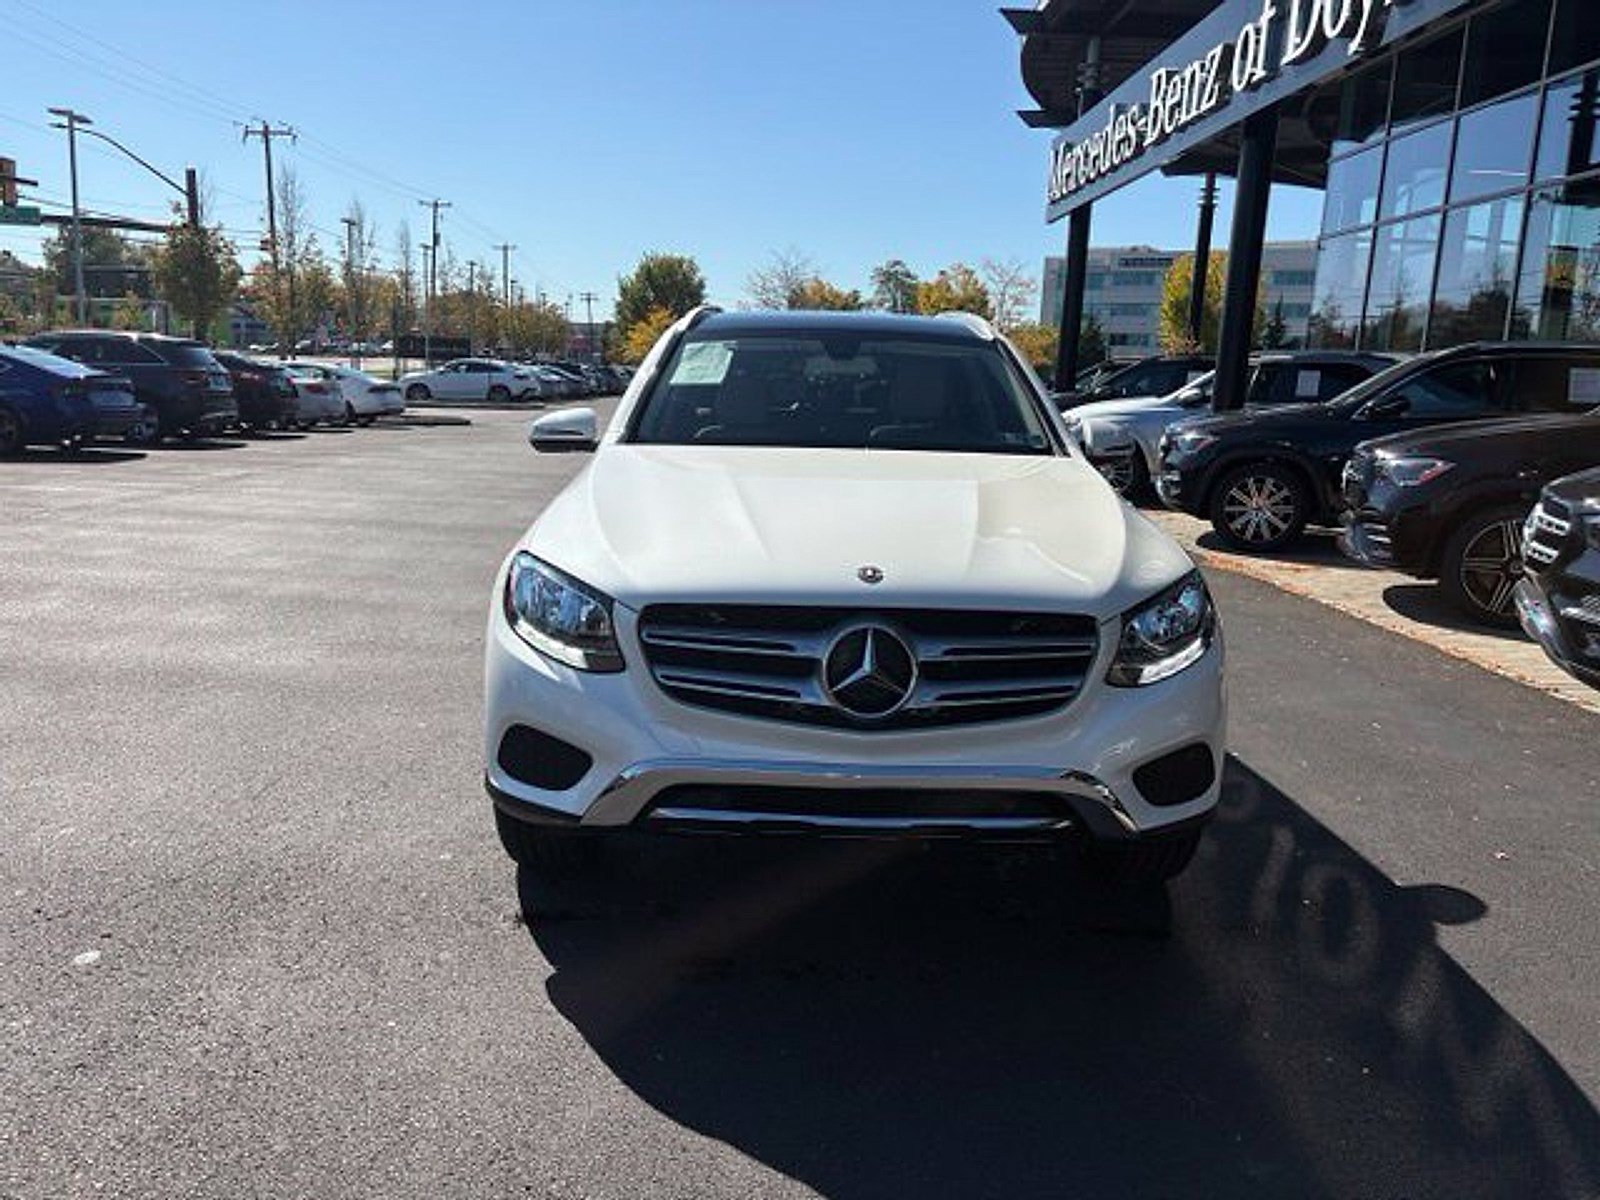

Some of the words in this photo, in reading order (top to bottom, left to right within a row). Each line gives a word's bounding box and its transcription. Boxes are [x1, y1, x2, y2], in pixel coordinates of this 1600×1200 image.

[1049, 42, 1224, 199] Mercedes-Benz
[1232, 0, 1276, 91] of
[1280, 0, 1391, 66] Doy
